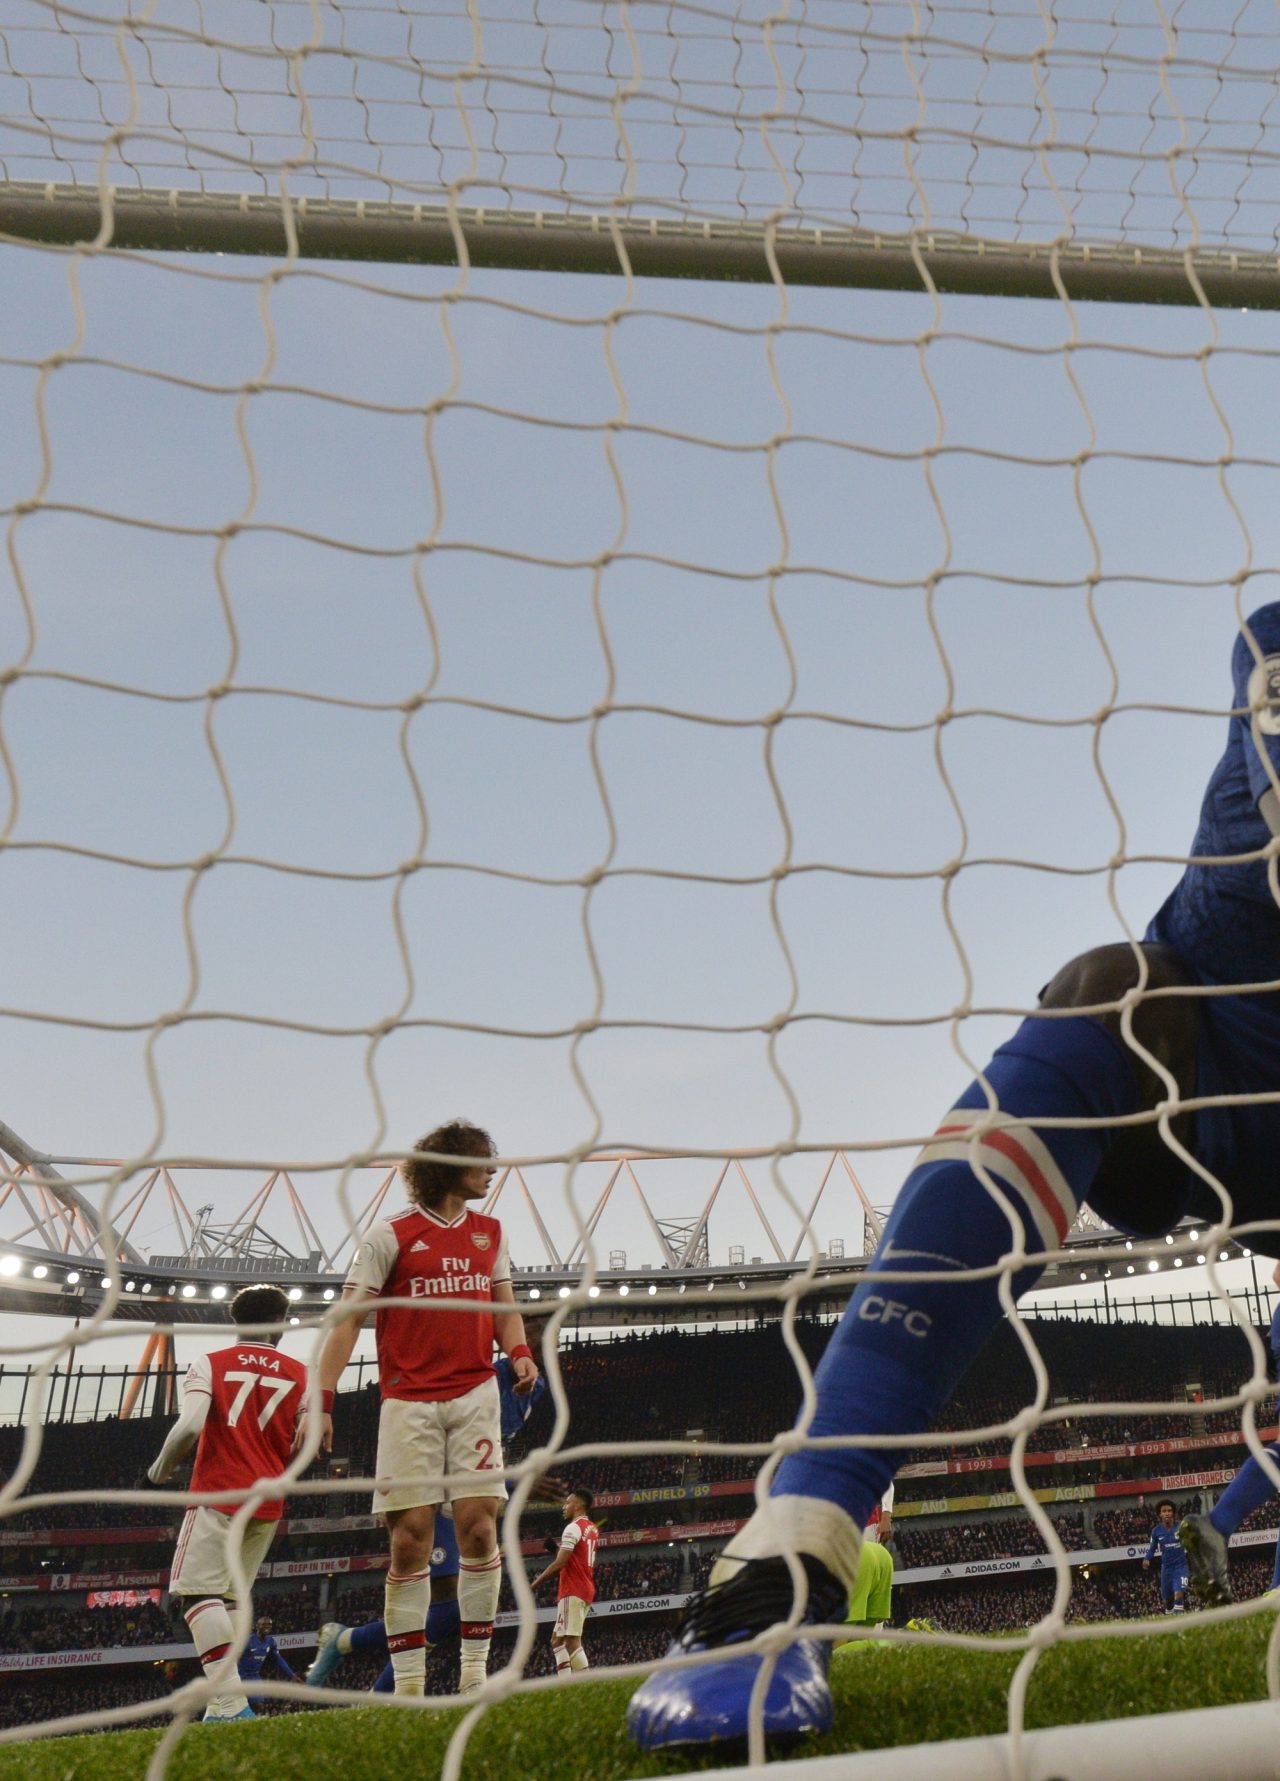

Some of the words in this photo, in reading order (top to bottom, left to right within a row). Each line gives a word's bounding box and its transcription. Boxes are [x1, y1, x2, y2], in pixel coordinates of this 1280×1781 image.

[441, 1257, 470, 1272] Fly
[409, 1271, 492, 1298] Emirate
[859, 1295, 932, 1337] CFC
[237, 1353, 281, 1373] SAKA
[223, 1370, 297, 1433] 77
[1140, 1443, 1166, 1454] 1993
[1188, 1435, 1230, 1449] ARSENAL
[968, 1460, 993, 1471] 1993
[1166, 1475, 1196, 1490] ARSENAL
[1197, 1471, 1223, 1486] FRANCE
[594, 1495, 621, 1507] 1989
[631, 1487, 686, 1503] ANFIELD
[920, 1500, 949, 1515] AND
[988, 1494, 1016, 1508] AND
[1056, 1485, 1095, 1501] AGAIN
[1240, 1533, 1269, 1544] Emirates
[965, 1561, 1020, 1574] ADIDAS.COM
[115, 1572, 161, 1585] Arsenal
[1180, 1576, 1189, 1586] 10
[609, 1599, 670, 1612] ADIDAS.COM
[279, 1636, 305, 1647] Dubai
[25, 1654, 45, 1667] LIFE
[47, 1652, 102, 1665] INSURANCE
